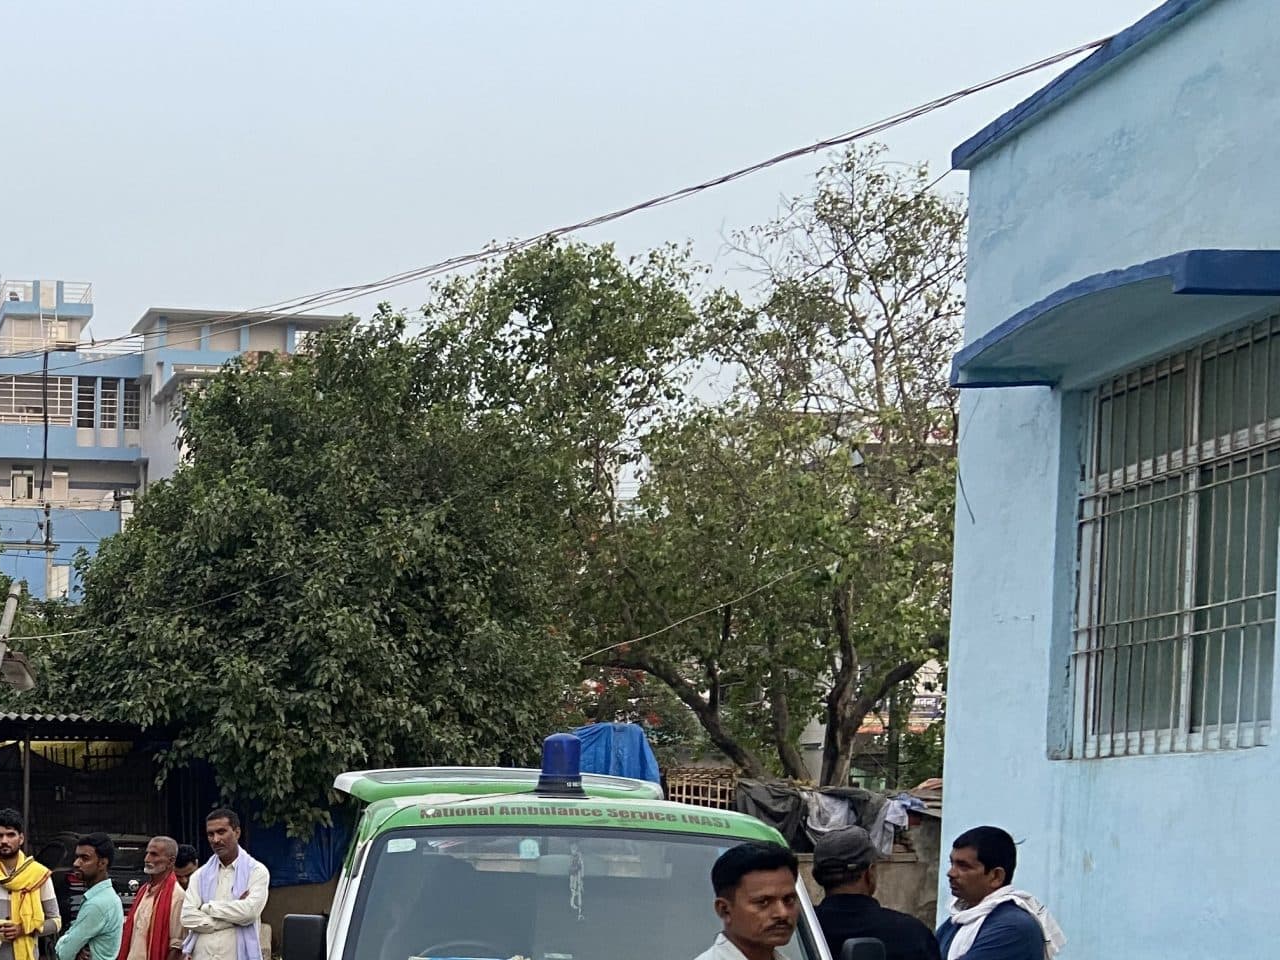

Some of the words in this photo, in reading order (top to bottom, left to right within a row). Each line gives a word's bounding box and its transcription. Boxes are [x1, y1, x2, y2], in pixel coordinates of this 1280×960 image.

[421, 806, 495, 819] National
[499, 806, 603, 817] Ambulance
[607, 808, 677, 822] Service
[682, 814, 731, 829] (NAS)
